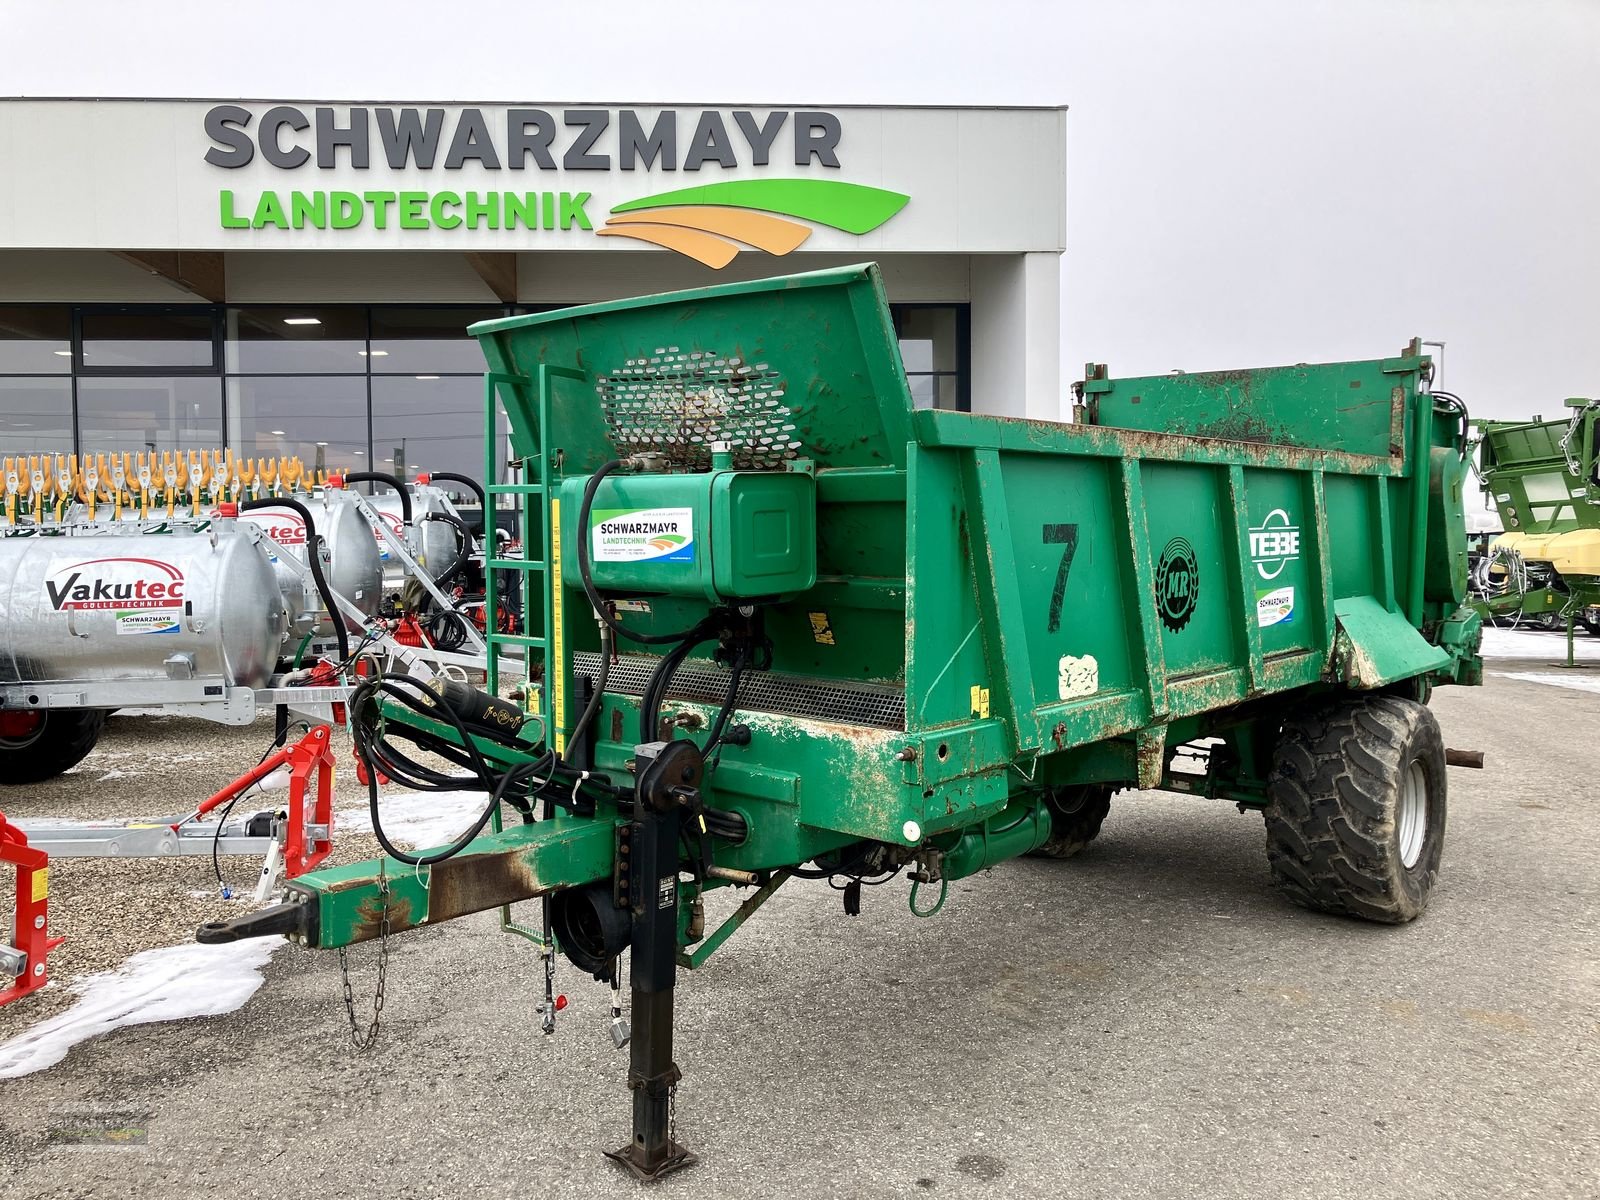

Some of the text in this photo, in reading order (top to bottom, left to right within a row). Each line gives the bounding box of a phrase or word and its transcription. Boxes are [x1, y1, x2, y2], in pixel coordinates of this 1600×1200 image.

[203, 105, 841, 172] SCHWARZMAYR
[220, 190, 594, 230] LANDTECHNIK
[601, 523, 678, 534] SCHWARZMAYR
[603, 537, 647, 545] LANDTECHNIK
[46, 573, 184, 610] Vakutec
[1042, 523, 1080, 634] 7
[1167, 571, 1189, 599] MR
